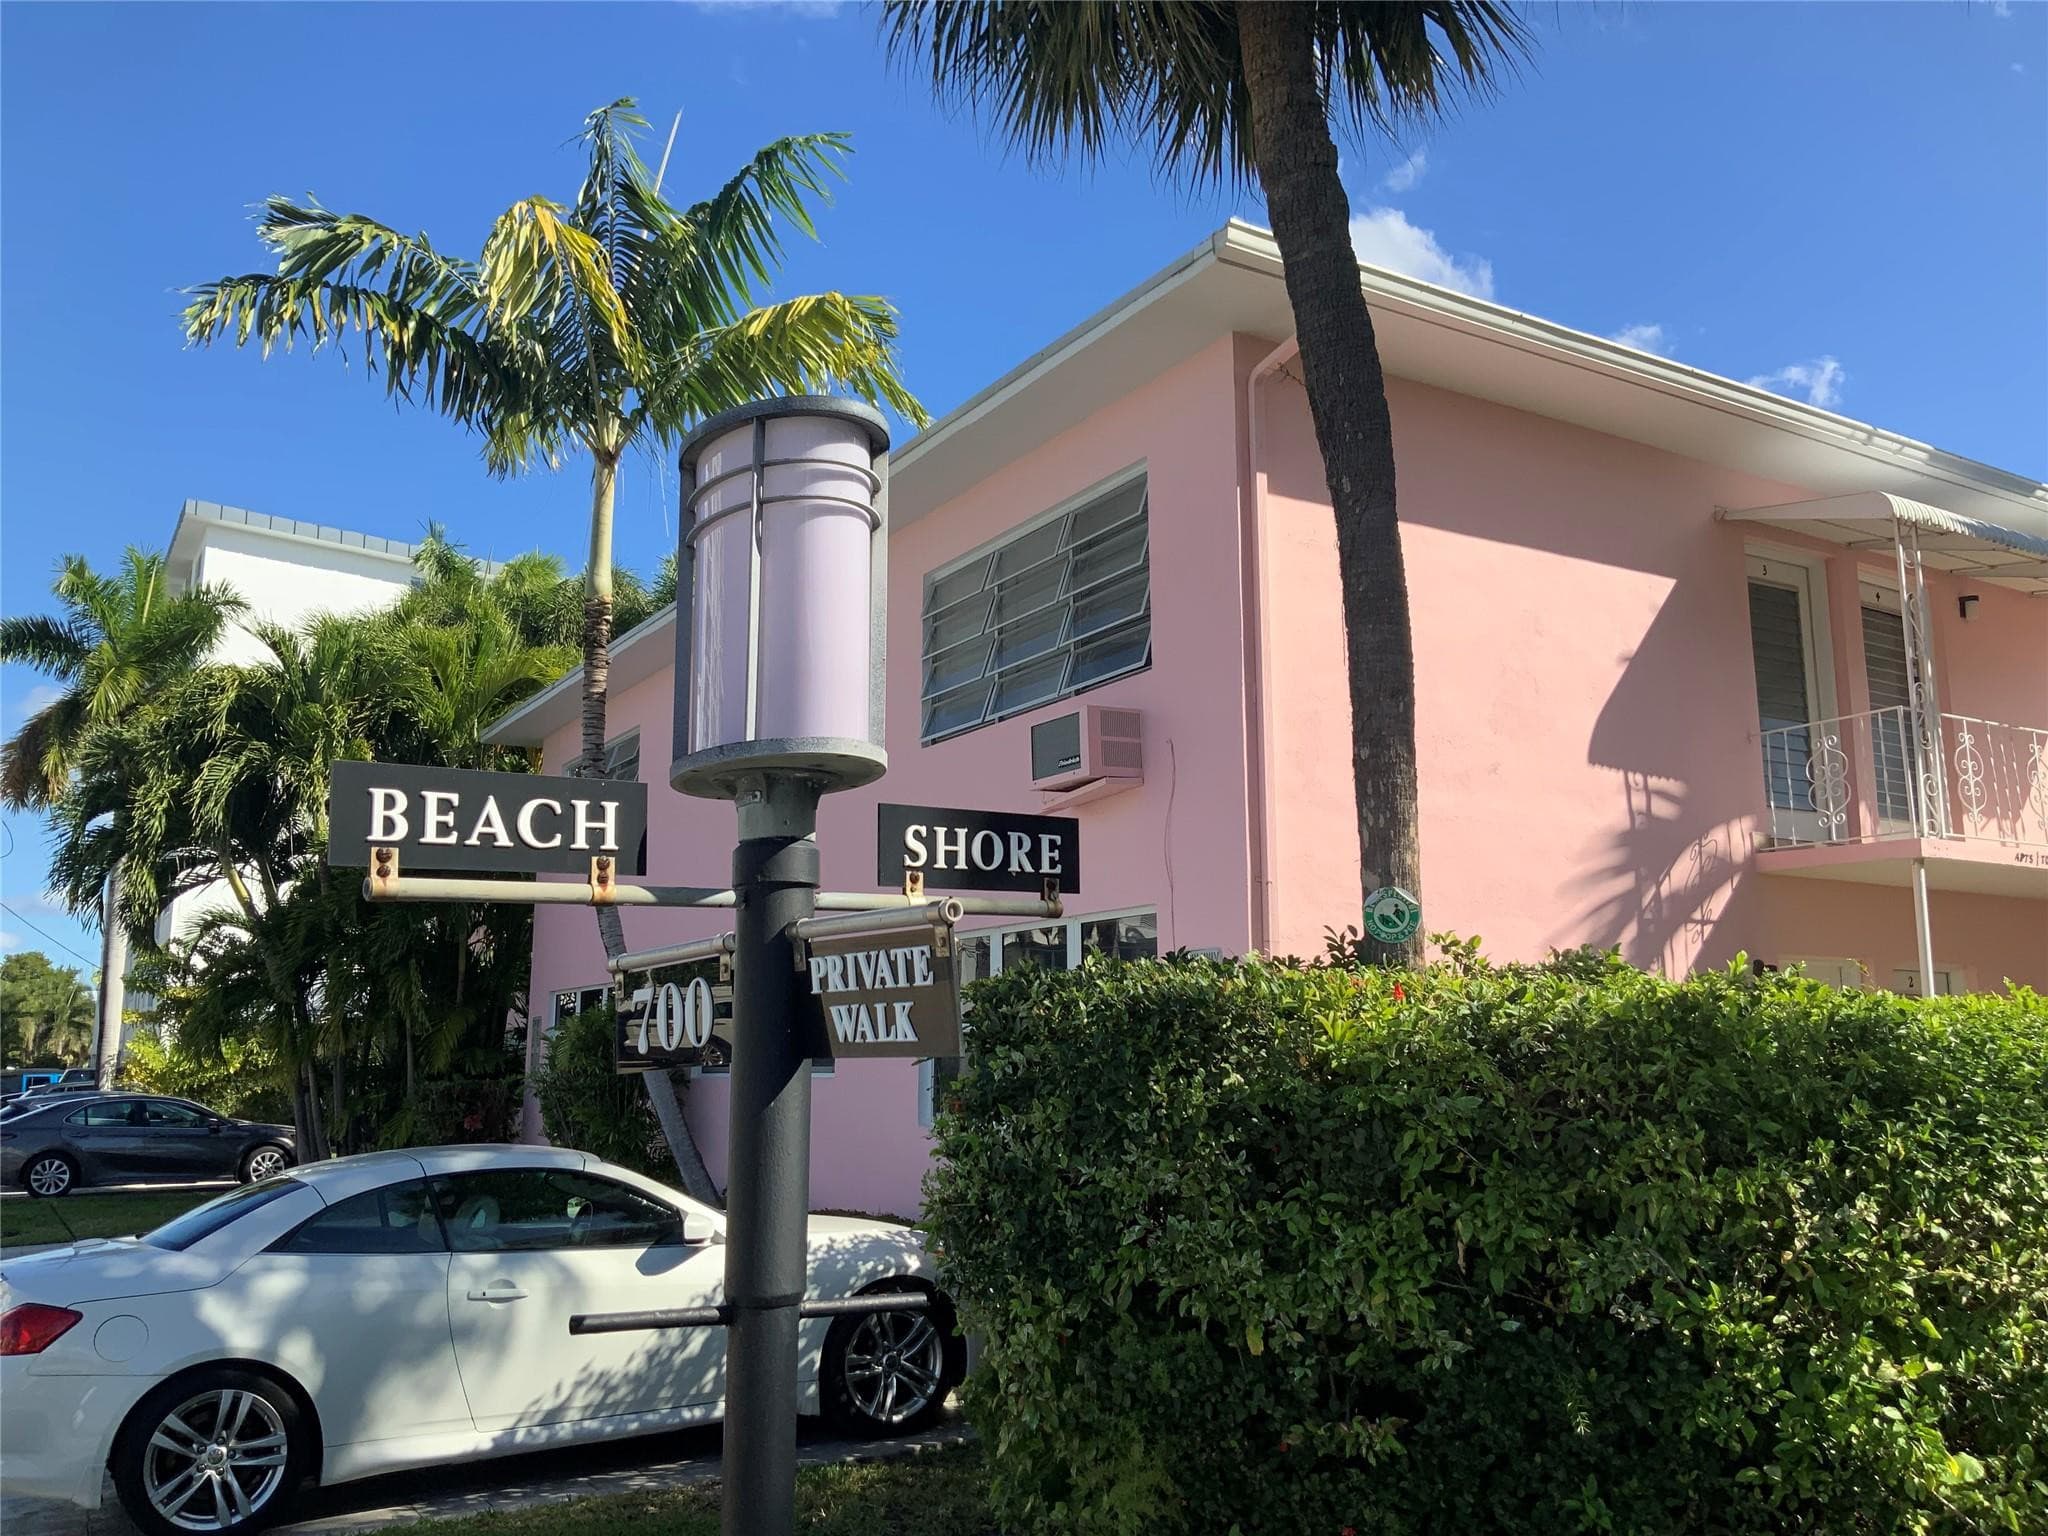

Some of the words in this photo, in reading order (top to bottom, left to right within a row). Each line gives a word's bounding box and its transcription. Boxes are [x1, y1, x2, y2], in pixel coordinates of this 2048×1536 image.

[1762, 565, 1767, 576] 3
[365, 787, 620, 850] BEACH
[903, 824, 1062, 874] SHORE
[2014, 852, 2033, 864] APTS
[808, 944, 934, 995] PRIVATE
[1908, 976, 1914, 988] 2
[632, 976, 714, 1055] 700
[829, 1001, 919, 1043] WALK
